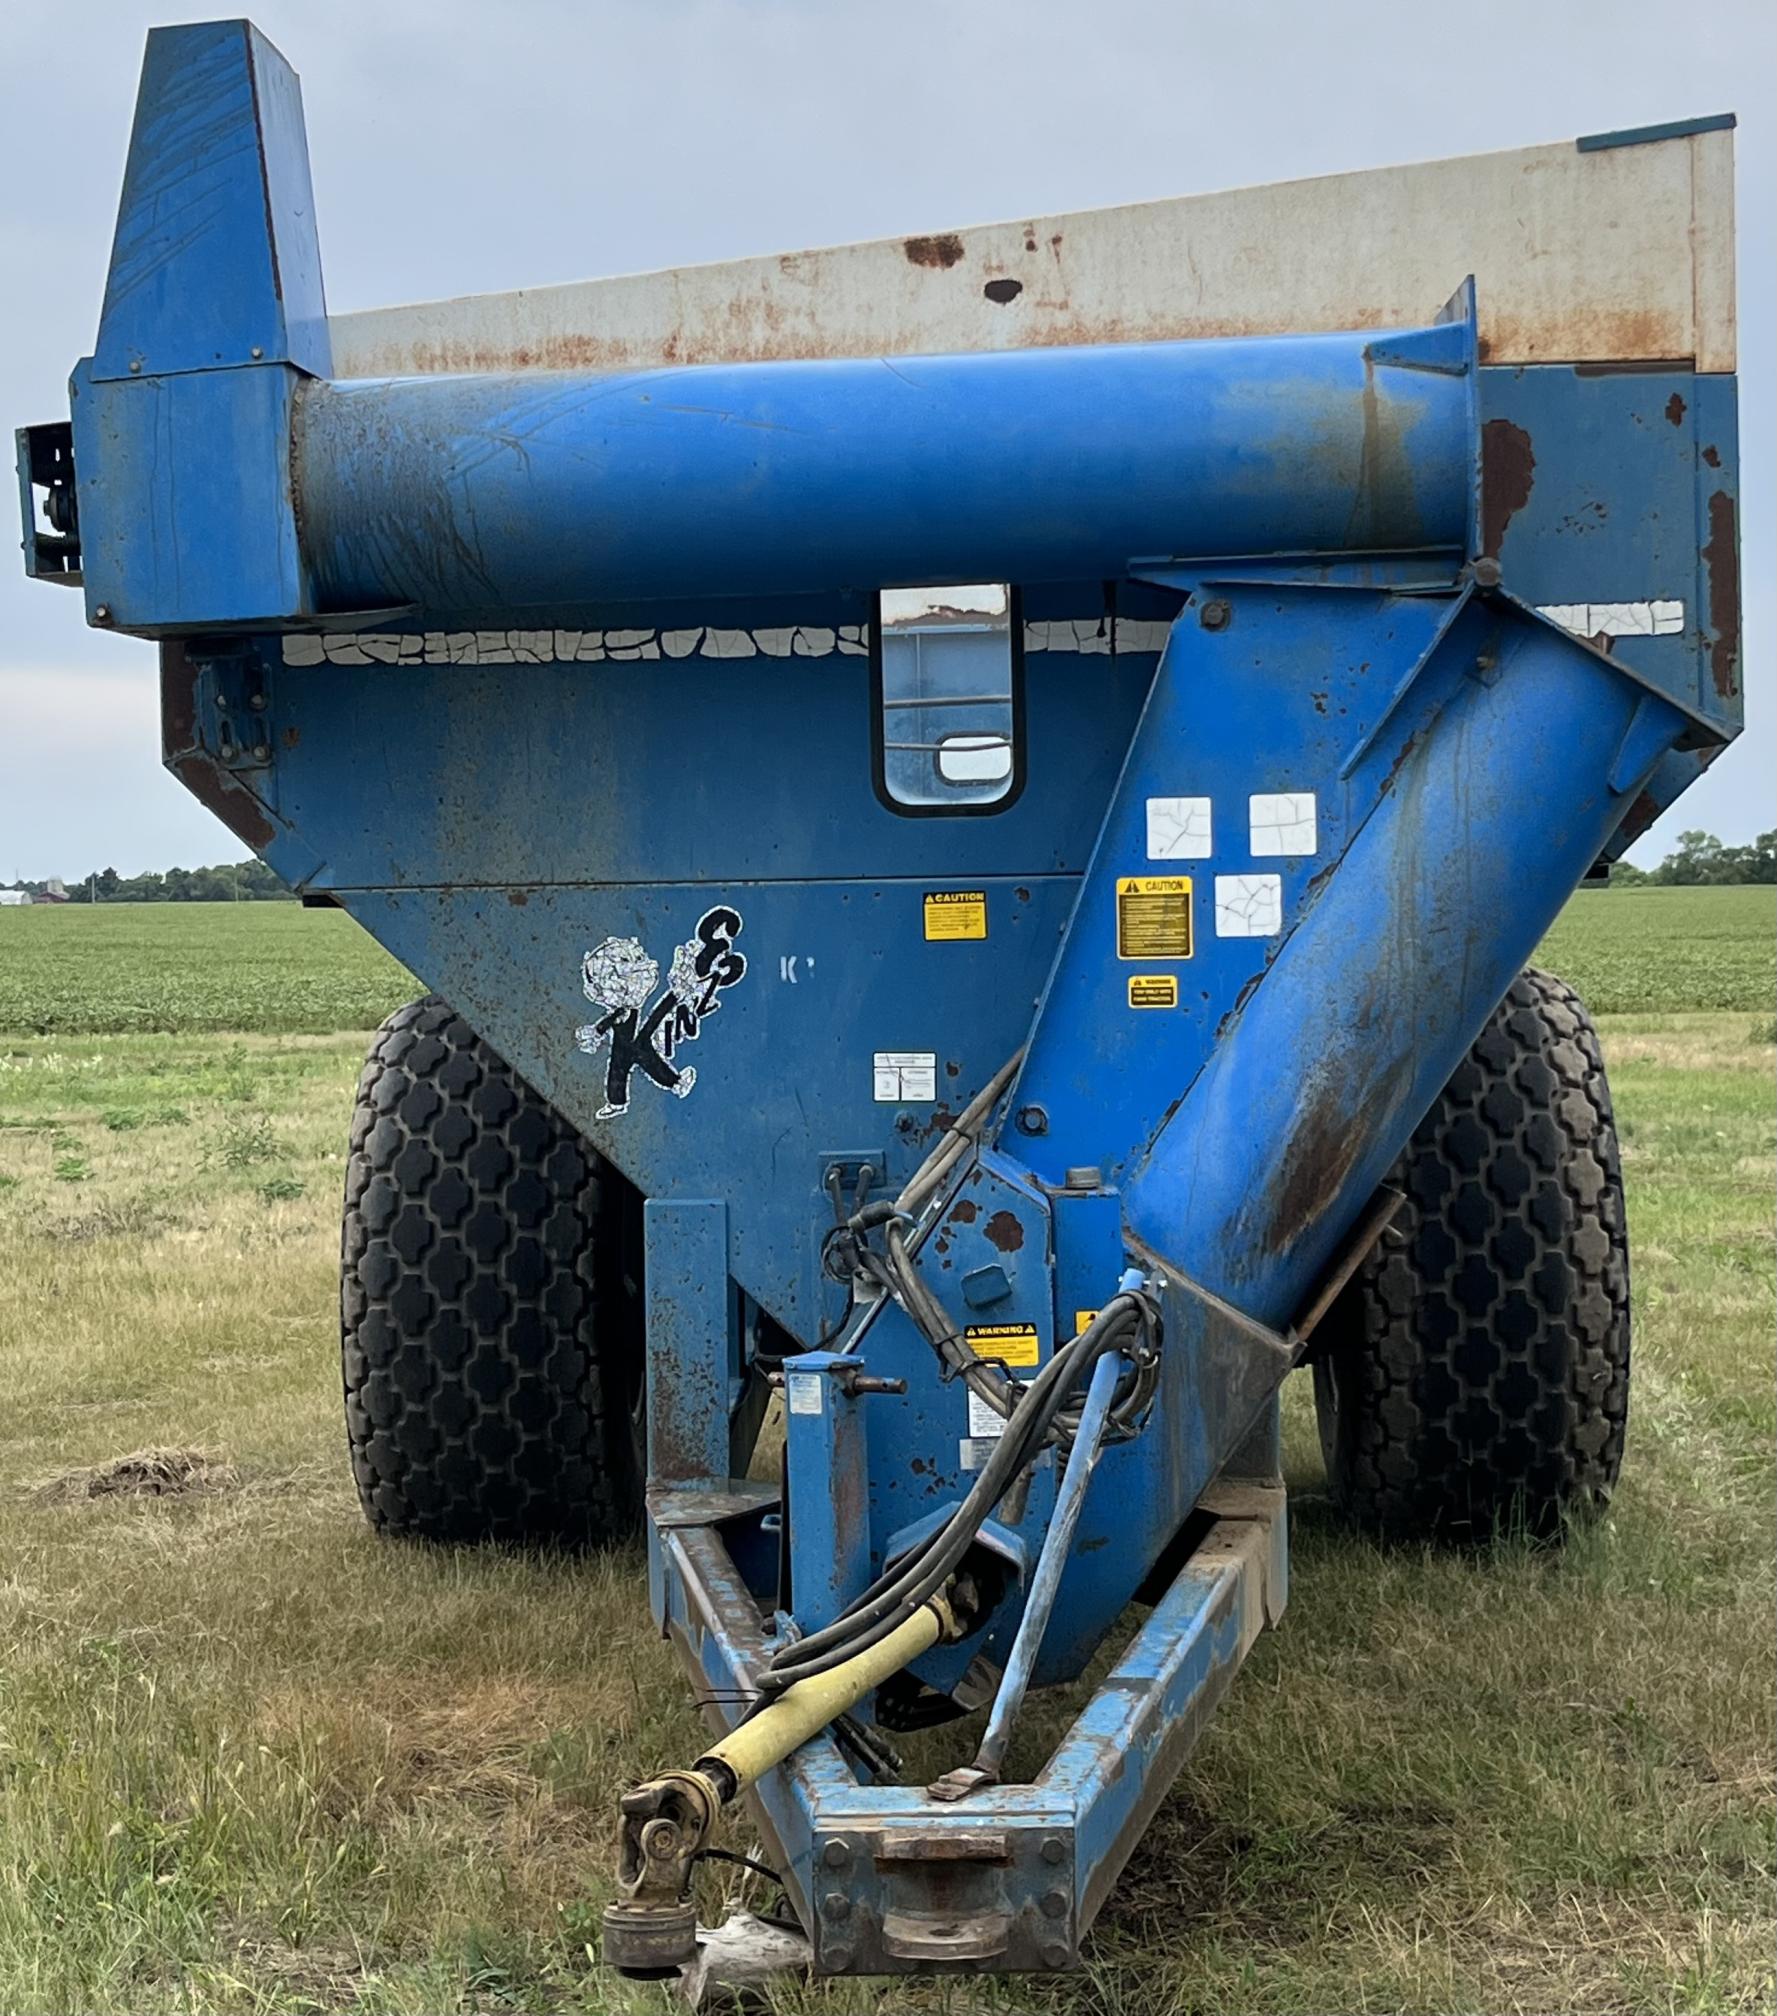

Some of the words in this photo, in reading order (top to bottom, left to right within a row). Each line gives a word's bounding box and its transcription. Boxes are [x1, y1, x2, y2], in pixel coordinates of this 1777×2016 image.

[1145, 880, 1184, 892] CAUTION
[934, 892, 985, 903] CAUTION
[977, 1325, 1023, 1336] WARNING
